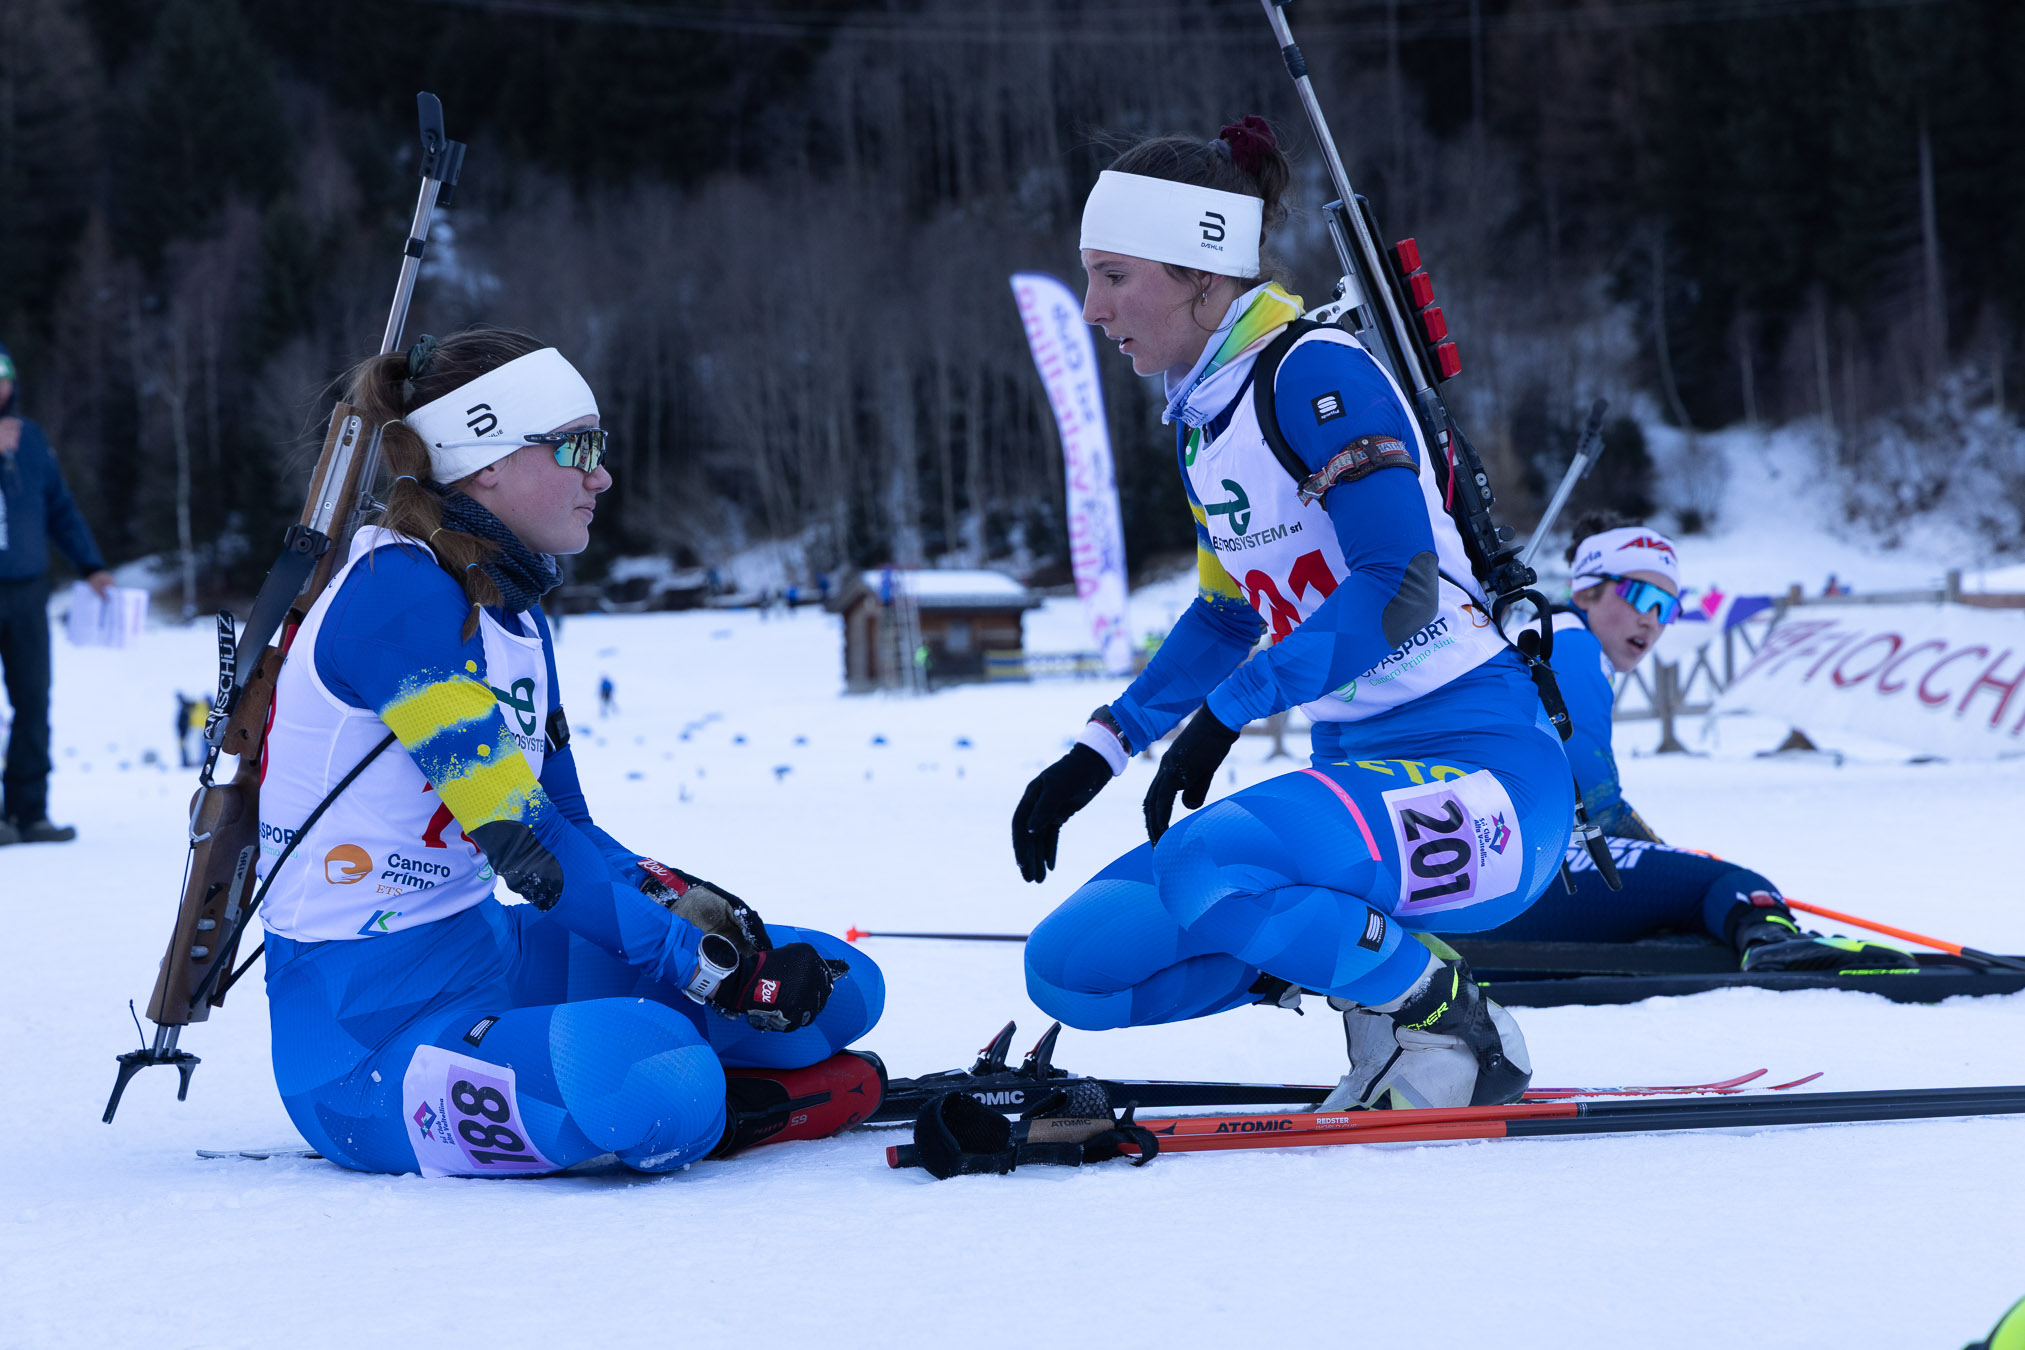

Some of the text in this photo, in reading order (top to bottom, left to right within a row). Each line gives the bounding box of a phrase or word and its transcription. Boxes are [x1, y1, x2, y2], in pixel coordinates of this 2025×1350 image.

[1290, 521, 1303, 534] srl
[1368, 668, 1401, 687] Cancro
[1400, 650, 1432, 672] Primo
[1483, 828, 1491, 843] Club
[1400, 799, 1472, 903] 201
[1478, 834, 1487, 868] Valtellina
[388, 853, 451, 878] Cancro
[639, 858, 668, 876] Rex
[376, 884, 403, 897] ETS
[761, 978, 777, 1003] Rex
[1402, 1001, 1450, 1031] CHER
[972, 1090, 1025, 1106] OMIC
[451, 1080, 540, 1165] 188
[1051, 1119, 1092, 1128] ATOMIC
[1214, 1119, 1293, 1134] ATOMIC
[1316, 1117, 1349, 1125] REDSTER
